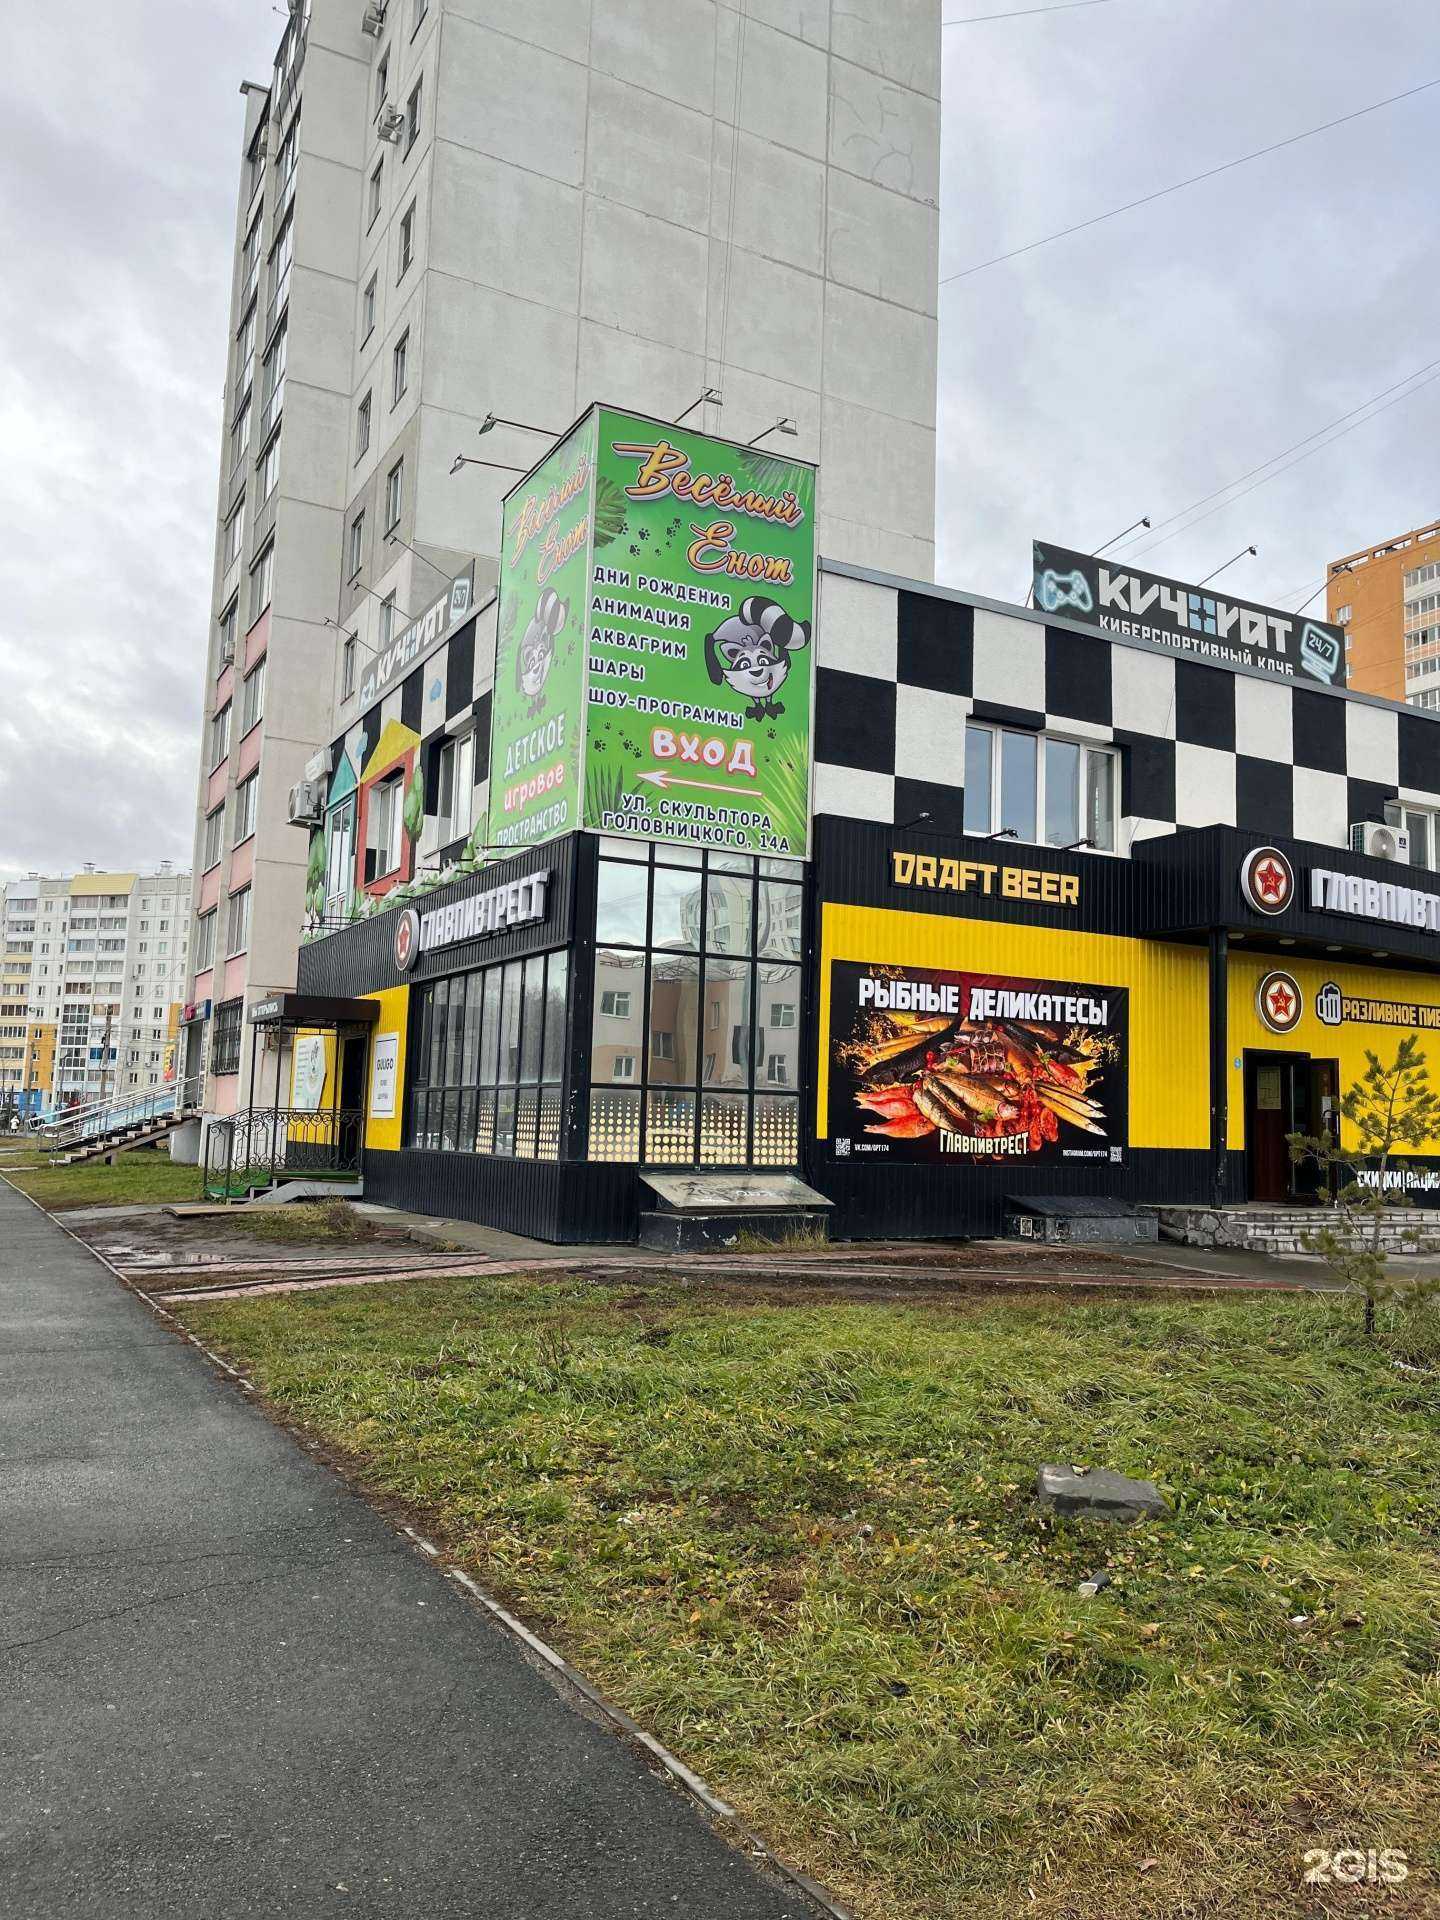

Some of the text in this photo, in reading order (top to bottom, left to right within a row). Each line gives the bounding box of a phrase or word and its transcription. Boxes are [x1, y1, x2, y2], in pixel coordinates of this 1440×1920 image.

[611, 440, 803, 525] Весёлый
[687, 521, 793, 584] Енот
[593, 566, 732, 609] ДНИ РОЖДЕНИЯ
[592, 596, 691, 630] АНИМАЦИЯ
[591, 626, 687, 659] АКВАГРИМ
[1099, 614, 1252, 665] КИБЕРСПОРТИВНЫЙ
[1307, 632, 1334, 659] 24/7
[588, 657, 645, 682] ШАРЫ
[588, 688, 744, 729] ШОУ-ПРОГРАММЫ
[504, 713, 565, 778] ДЕТСКОЕ
[652, 728, 757, 777] ВХОД
[504, 764, 564, 812] игровое
[622, 794, 772, 830] УЛ. СКУЛЬПТОРА
[497, 800, 567, 850] ПРОСТРАНСТВО
[603, 812, 790, 852] ГОЛОВНИЦКОГО, 14А
[893, 851, 1080, 906] DRAFT BEER
[1311, 868, 1440, 932] ГЛАВПИВТ
[419, 871, 549, 952] ГЛАВПИВТРЕСТ
[858, 977, 1108, 1027] РЫБНЫЕ ДЕЛИКАТЕСЫ
[1342, 999, 1417, 1025] РАЗЛИВНОЕ
[939, 1128, 1029, 1155] ГЛАВПИВТРЕСТ
